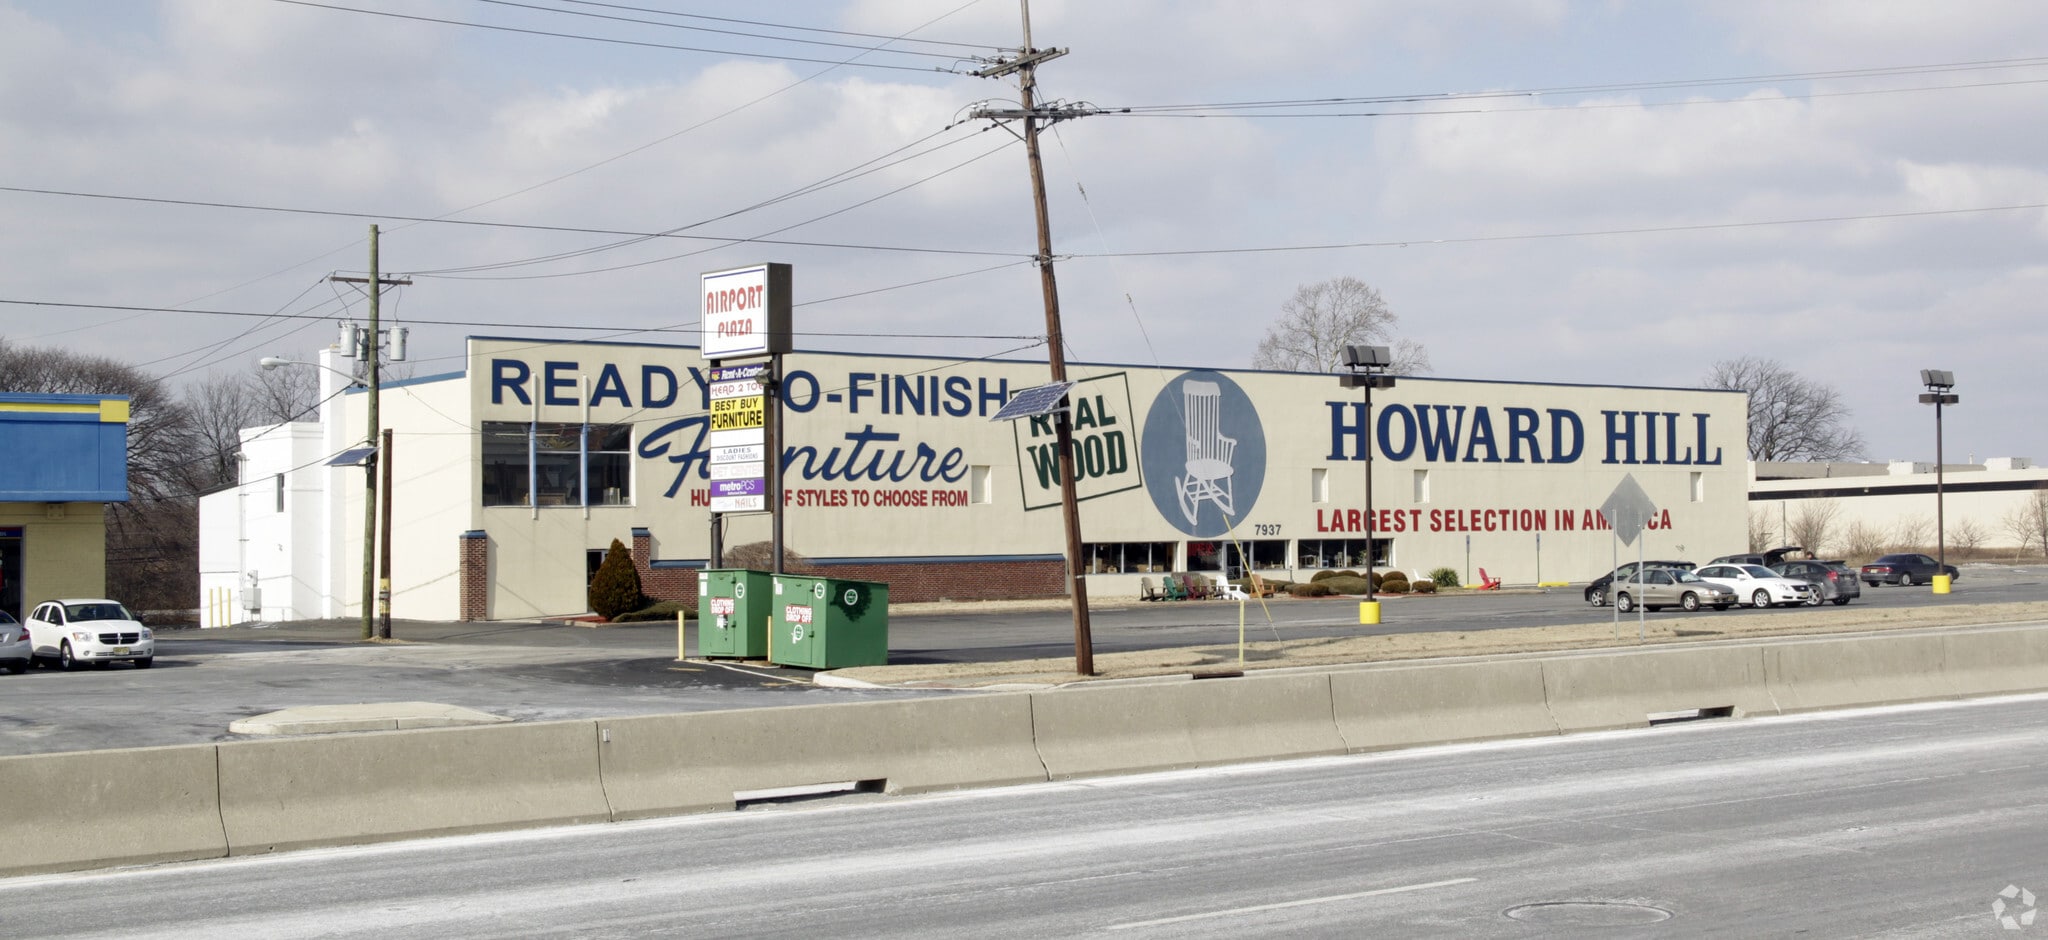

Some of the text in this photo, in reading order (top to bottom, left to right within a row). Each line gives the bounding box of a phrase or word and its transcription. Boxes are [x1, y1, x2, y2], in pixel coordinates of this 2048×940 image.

[706, 284, 763, 315] AIRPORT
[718, 318, 752, 338] PLAZA
[721, 367, 764, 380] Rent-A-Cente
[711, 384, 735, 397] HEAD
[738, 383, 744, 392] 2
[715, 398, 758, 411] BEST BUY
[711, 410, 762, 429] FURNITURE
[1029, 395, 1117, 438] RAL
[1325, 401, 1722, 465] HOWARD HILL
[637, 414, 968, 499] Fniture
[716, 452, 758, 462] DISCOUNT FASHIONS
[723, 447, 752, 455] LADIES
[1026, 430, 1128, 490] WOOD
[719, 480, 755, 492] metroPCS
[734, 497, 757, 509] NAILS
[796, 489, 848, 507] STYLES
[851, 490, 870, 507] TO
[873, 489, 928, 507] CHOOSE
[931, 490, 969, 507] FROM
[1316, 508, 1672, 532] LARGEST SELECTION IN AMCA
[1254, 523, 1282, 536] 7937
[710, 598, 734, 607] CLOTHING
[786, 605, 812, 615] CLOTHING
